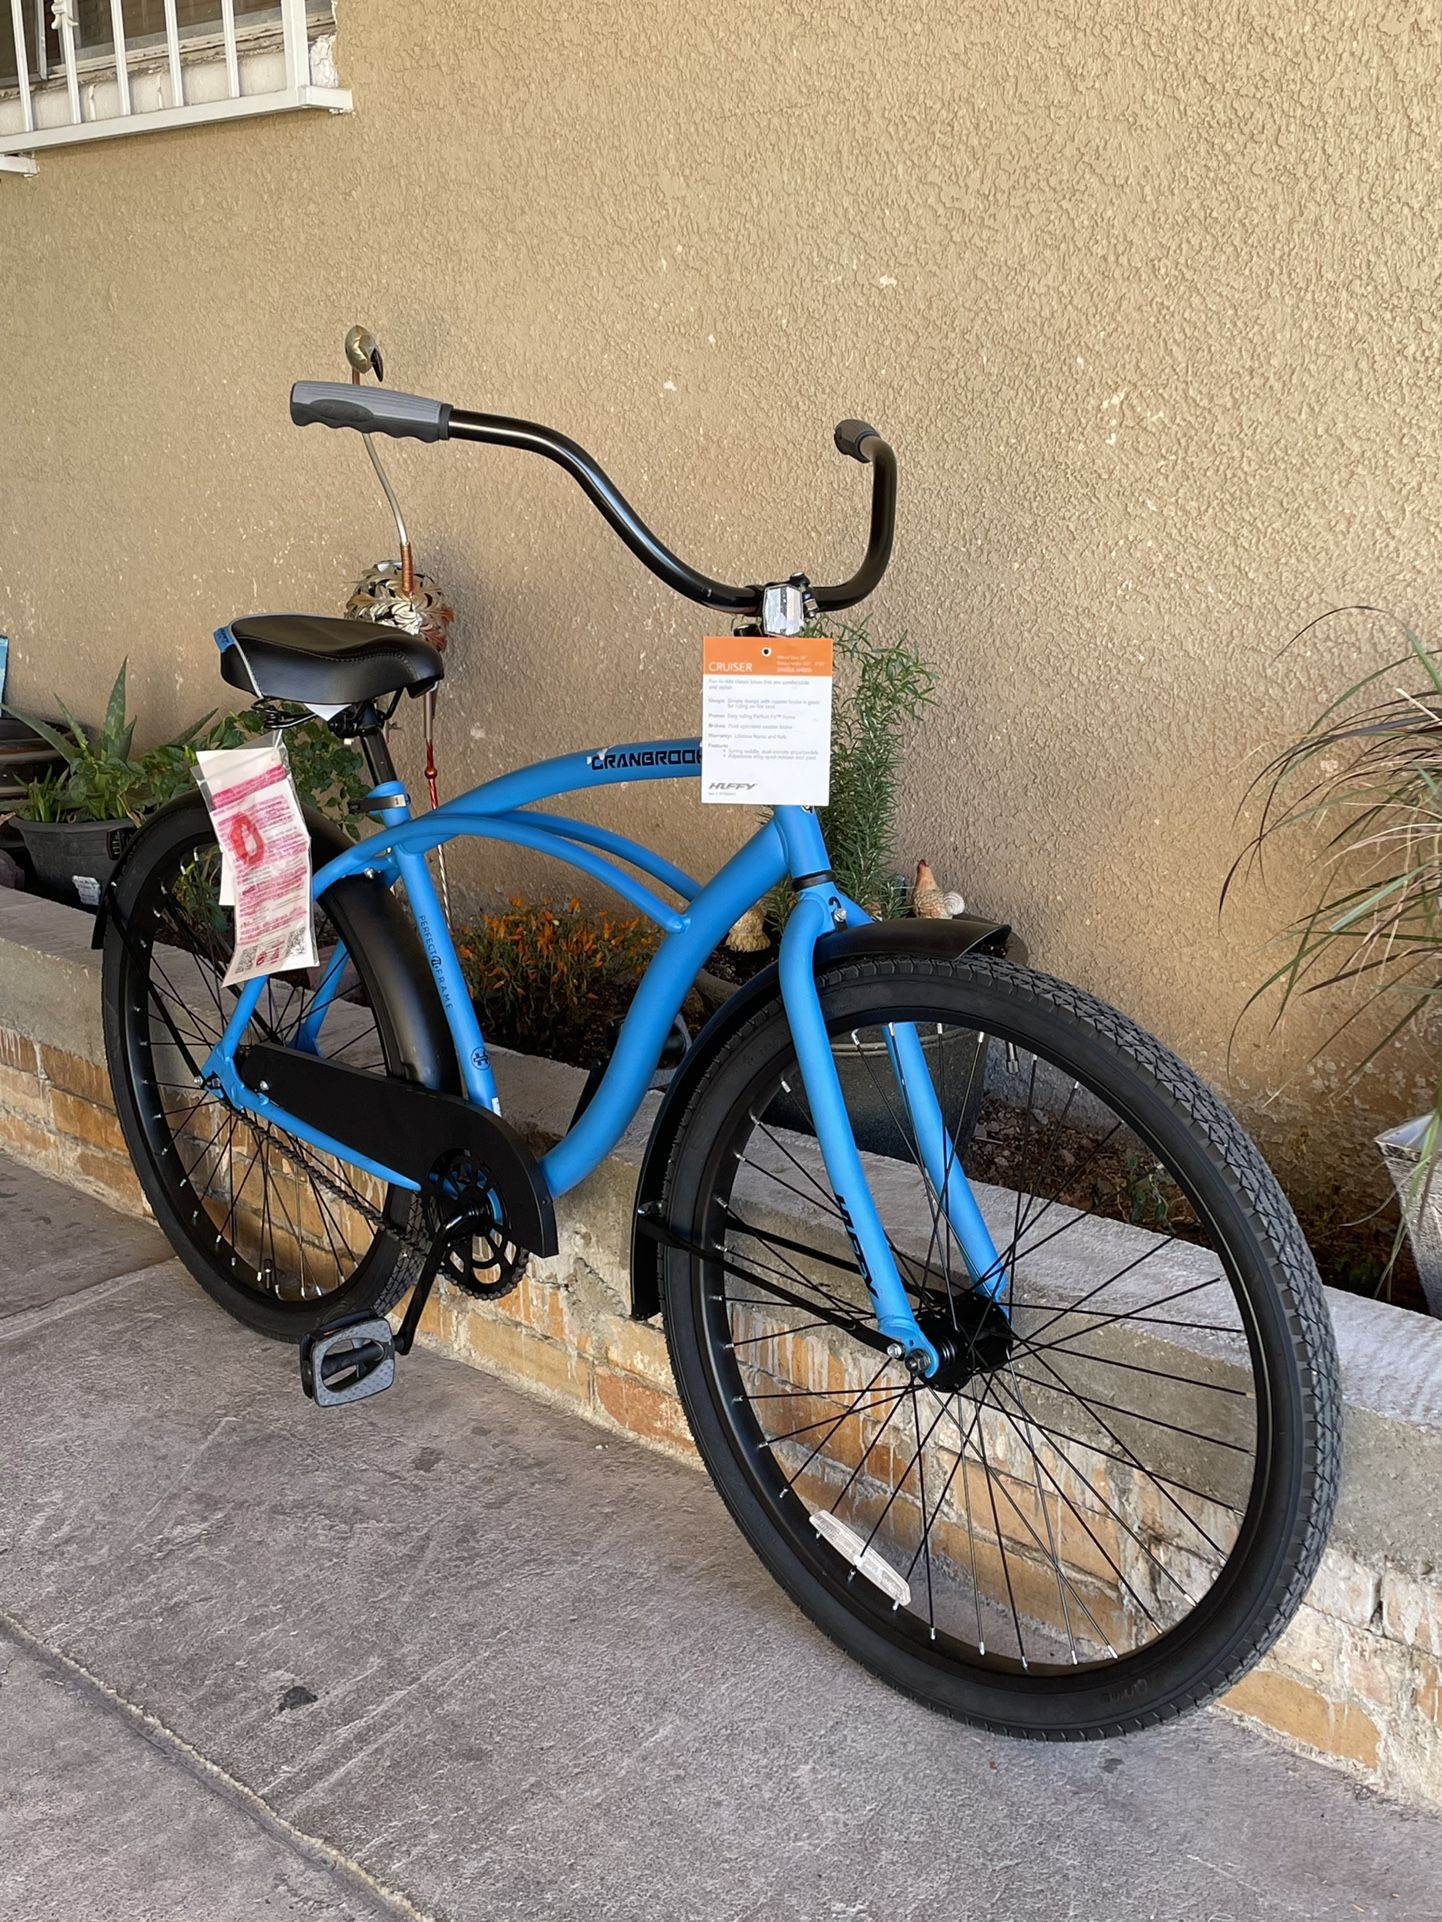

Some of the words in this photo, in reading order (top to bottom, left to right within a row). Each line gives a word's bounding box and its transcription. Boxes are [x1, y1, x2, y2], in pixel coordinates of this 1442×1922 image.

[708, 662, 753, 672] CRUISER
[708, 782, 757, 790] HUFFY
[418, 915, 438, 956] PERFECT
[435, 965, 453, 1010] FRAME
